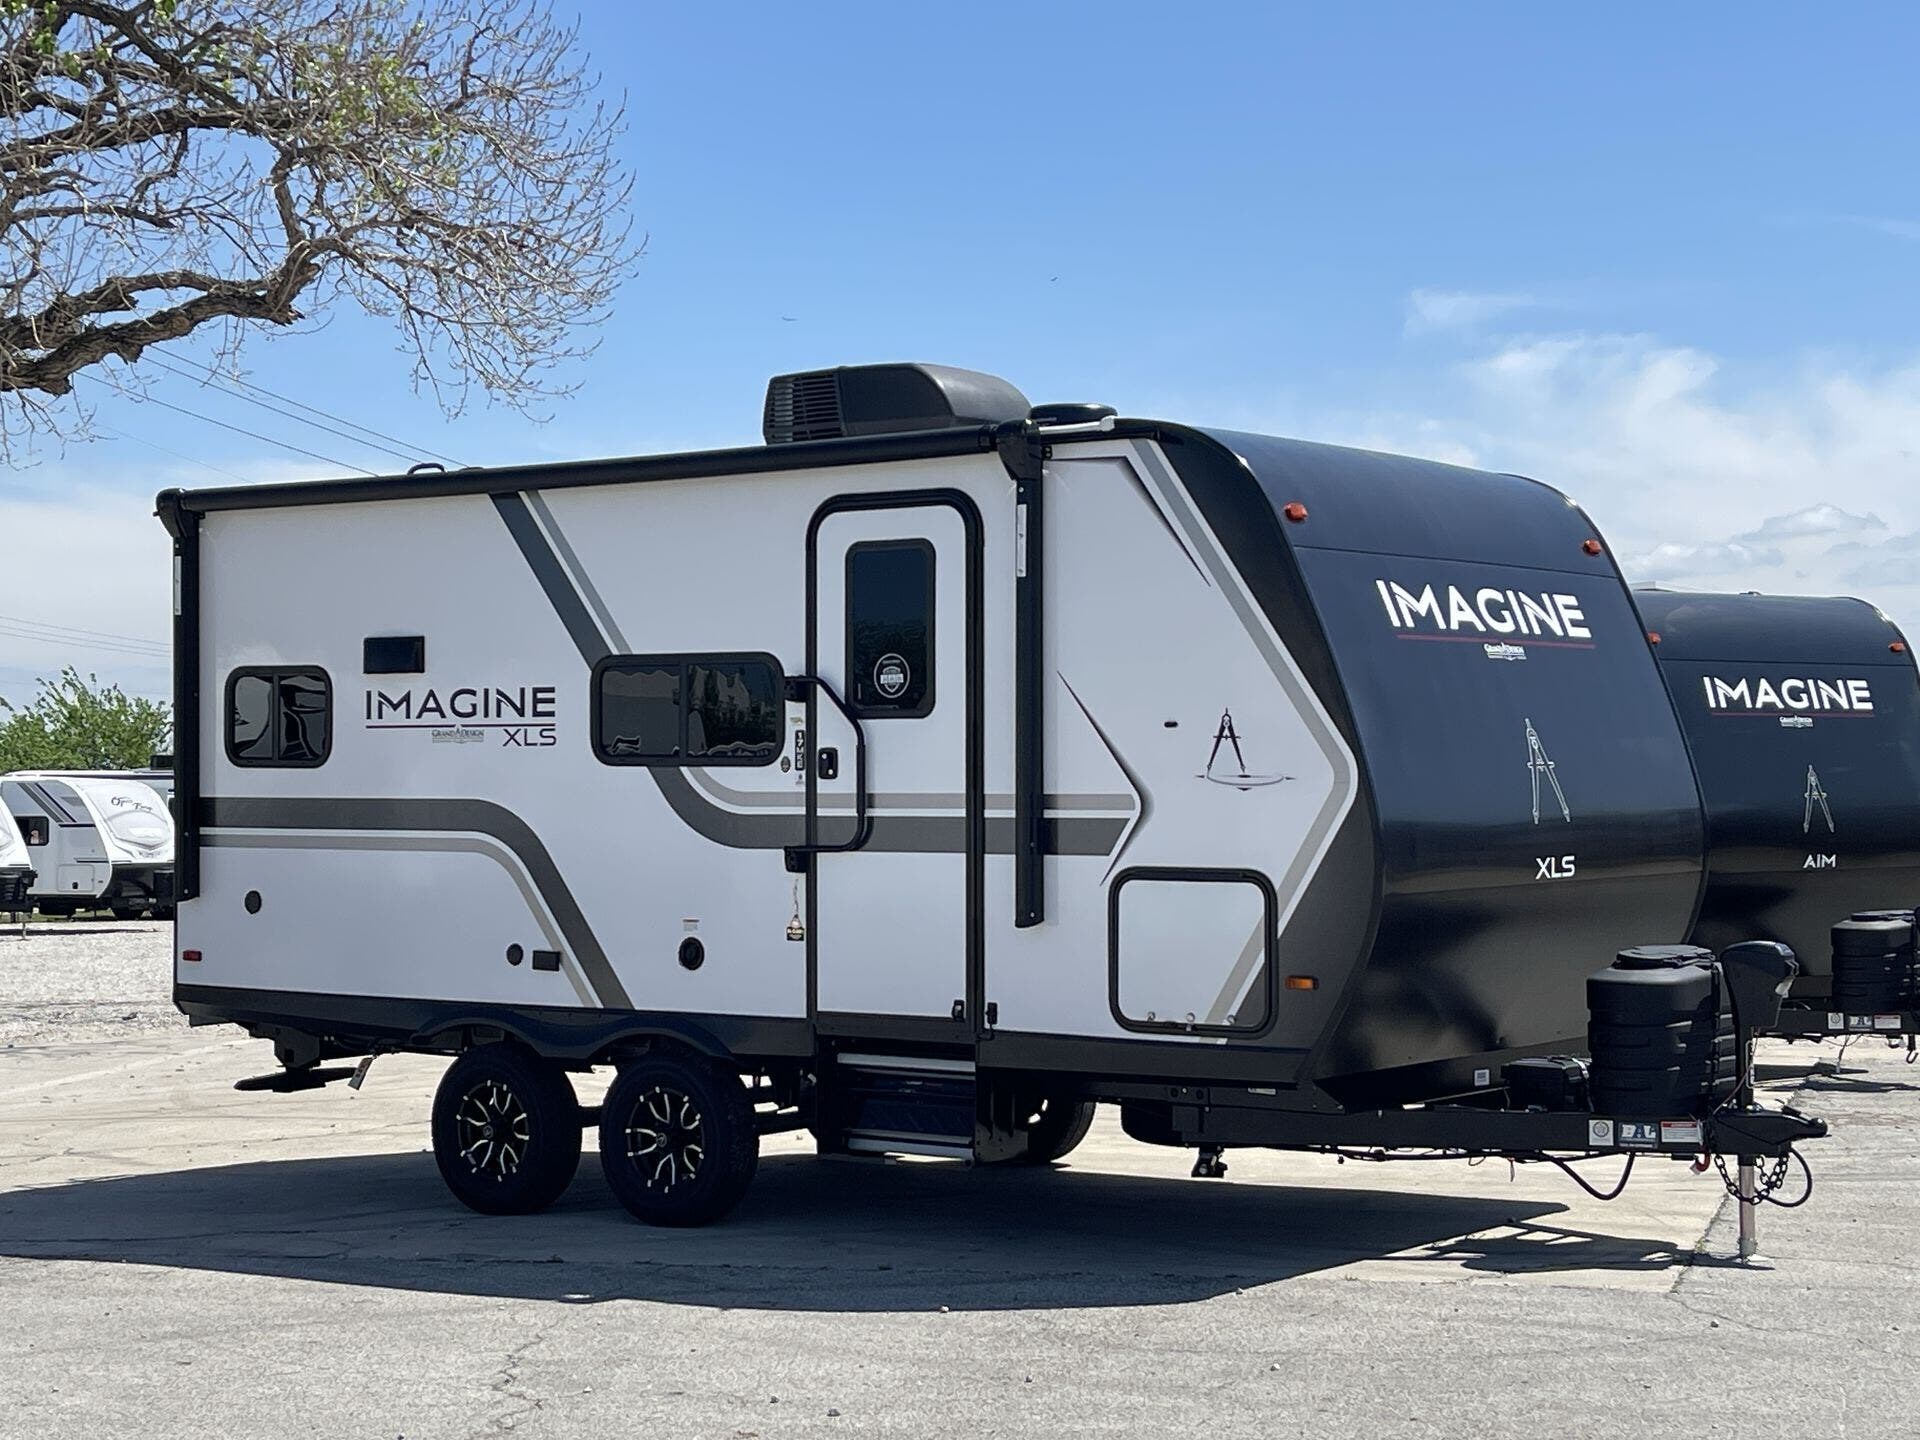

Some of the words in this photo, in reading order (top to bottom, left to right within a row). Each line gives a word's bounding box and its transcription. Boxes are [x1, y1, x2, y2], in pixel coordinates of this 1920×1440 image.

[1375, 579, 1592, 639] IMAGINE
[365, 686, 556, 720] IMAGINE
[1703, 676, 1874, 710] IMAGINE
[502, 728, 557, 747] XLS
[1535, 855, 1576, 880] XLS
[1803, 854, 1837, 869] AIM
